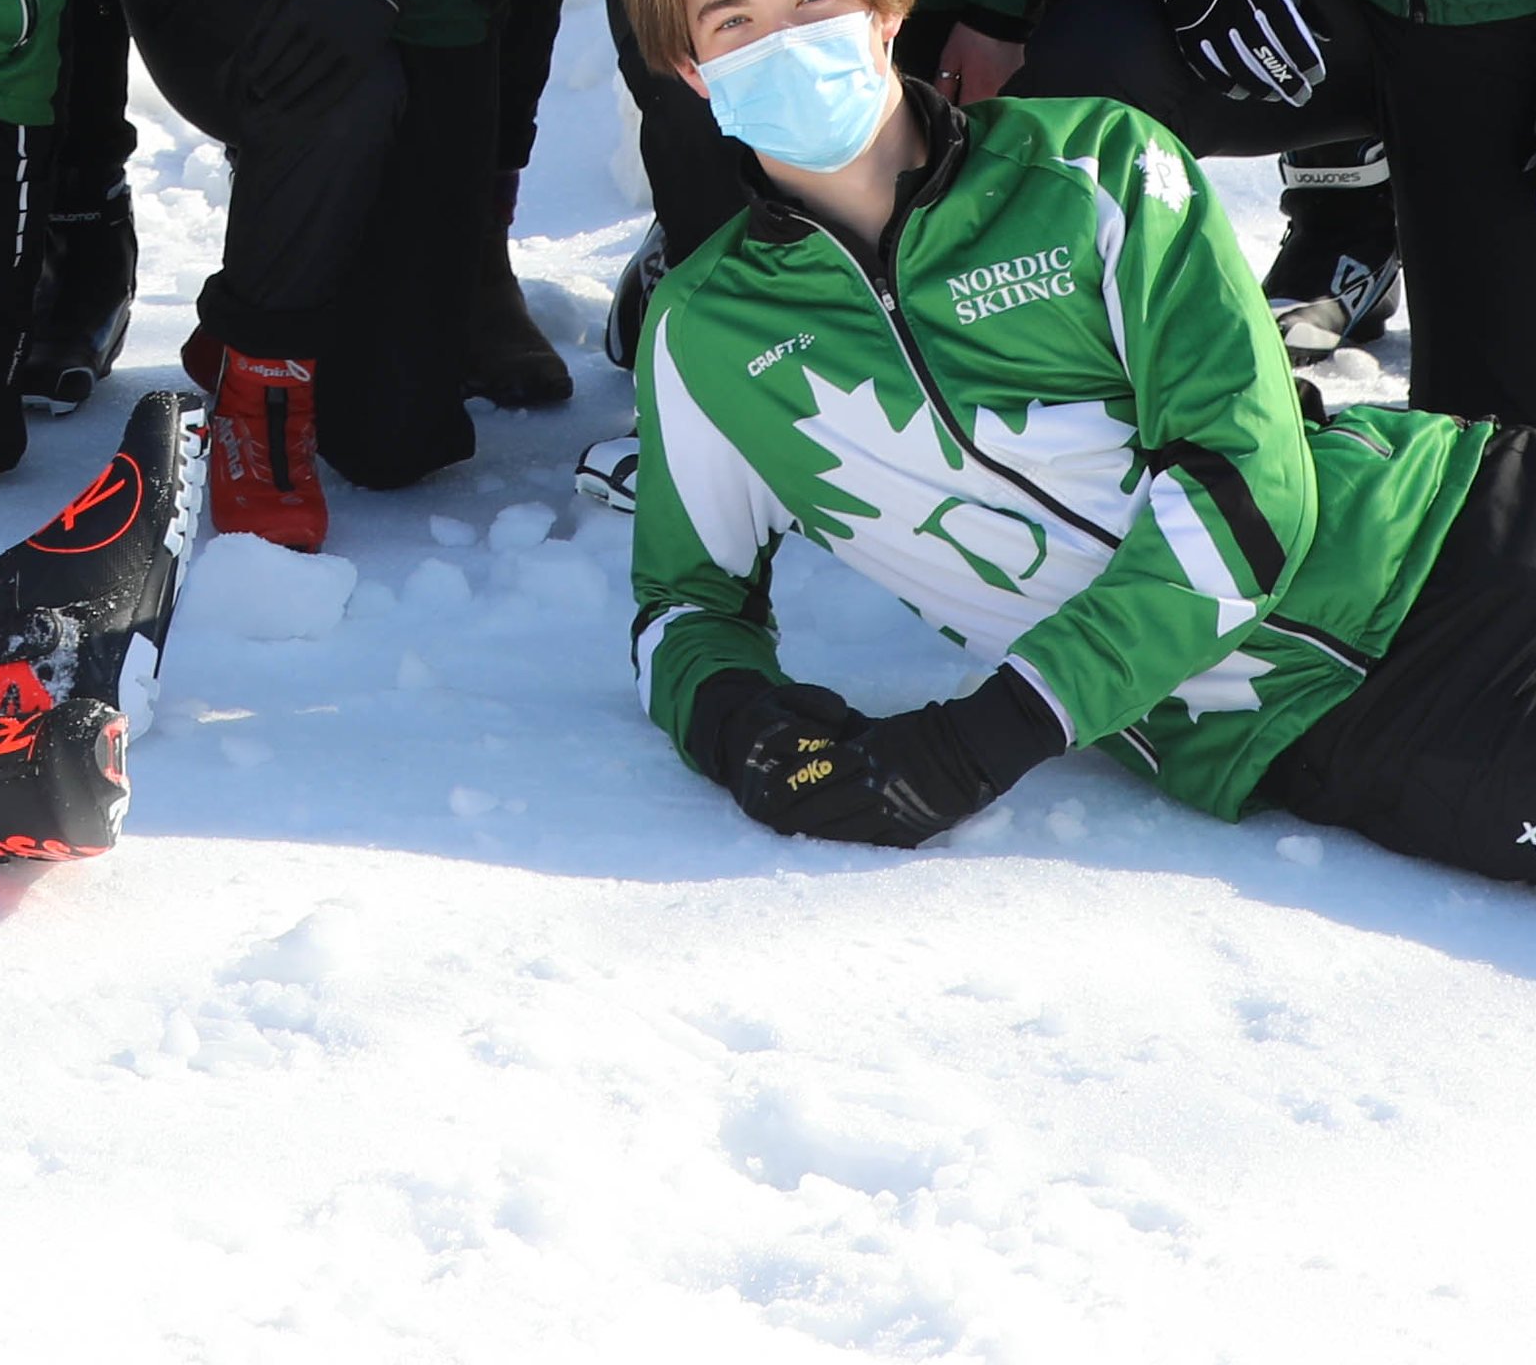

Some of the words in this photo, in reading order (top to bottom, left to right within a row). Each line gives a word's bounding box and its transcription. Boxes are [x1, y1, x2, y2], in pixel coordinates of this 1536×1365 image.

[1254, 43, 1291, 84] swix
[947, 246, 1072, 302] NORDIC
[956, 270, 1076, 326] SKIING
[748, 340, 796, 377] CRAFT
[787, 758, 833, 791] TOKO
